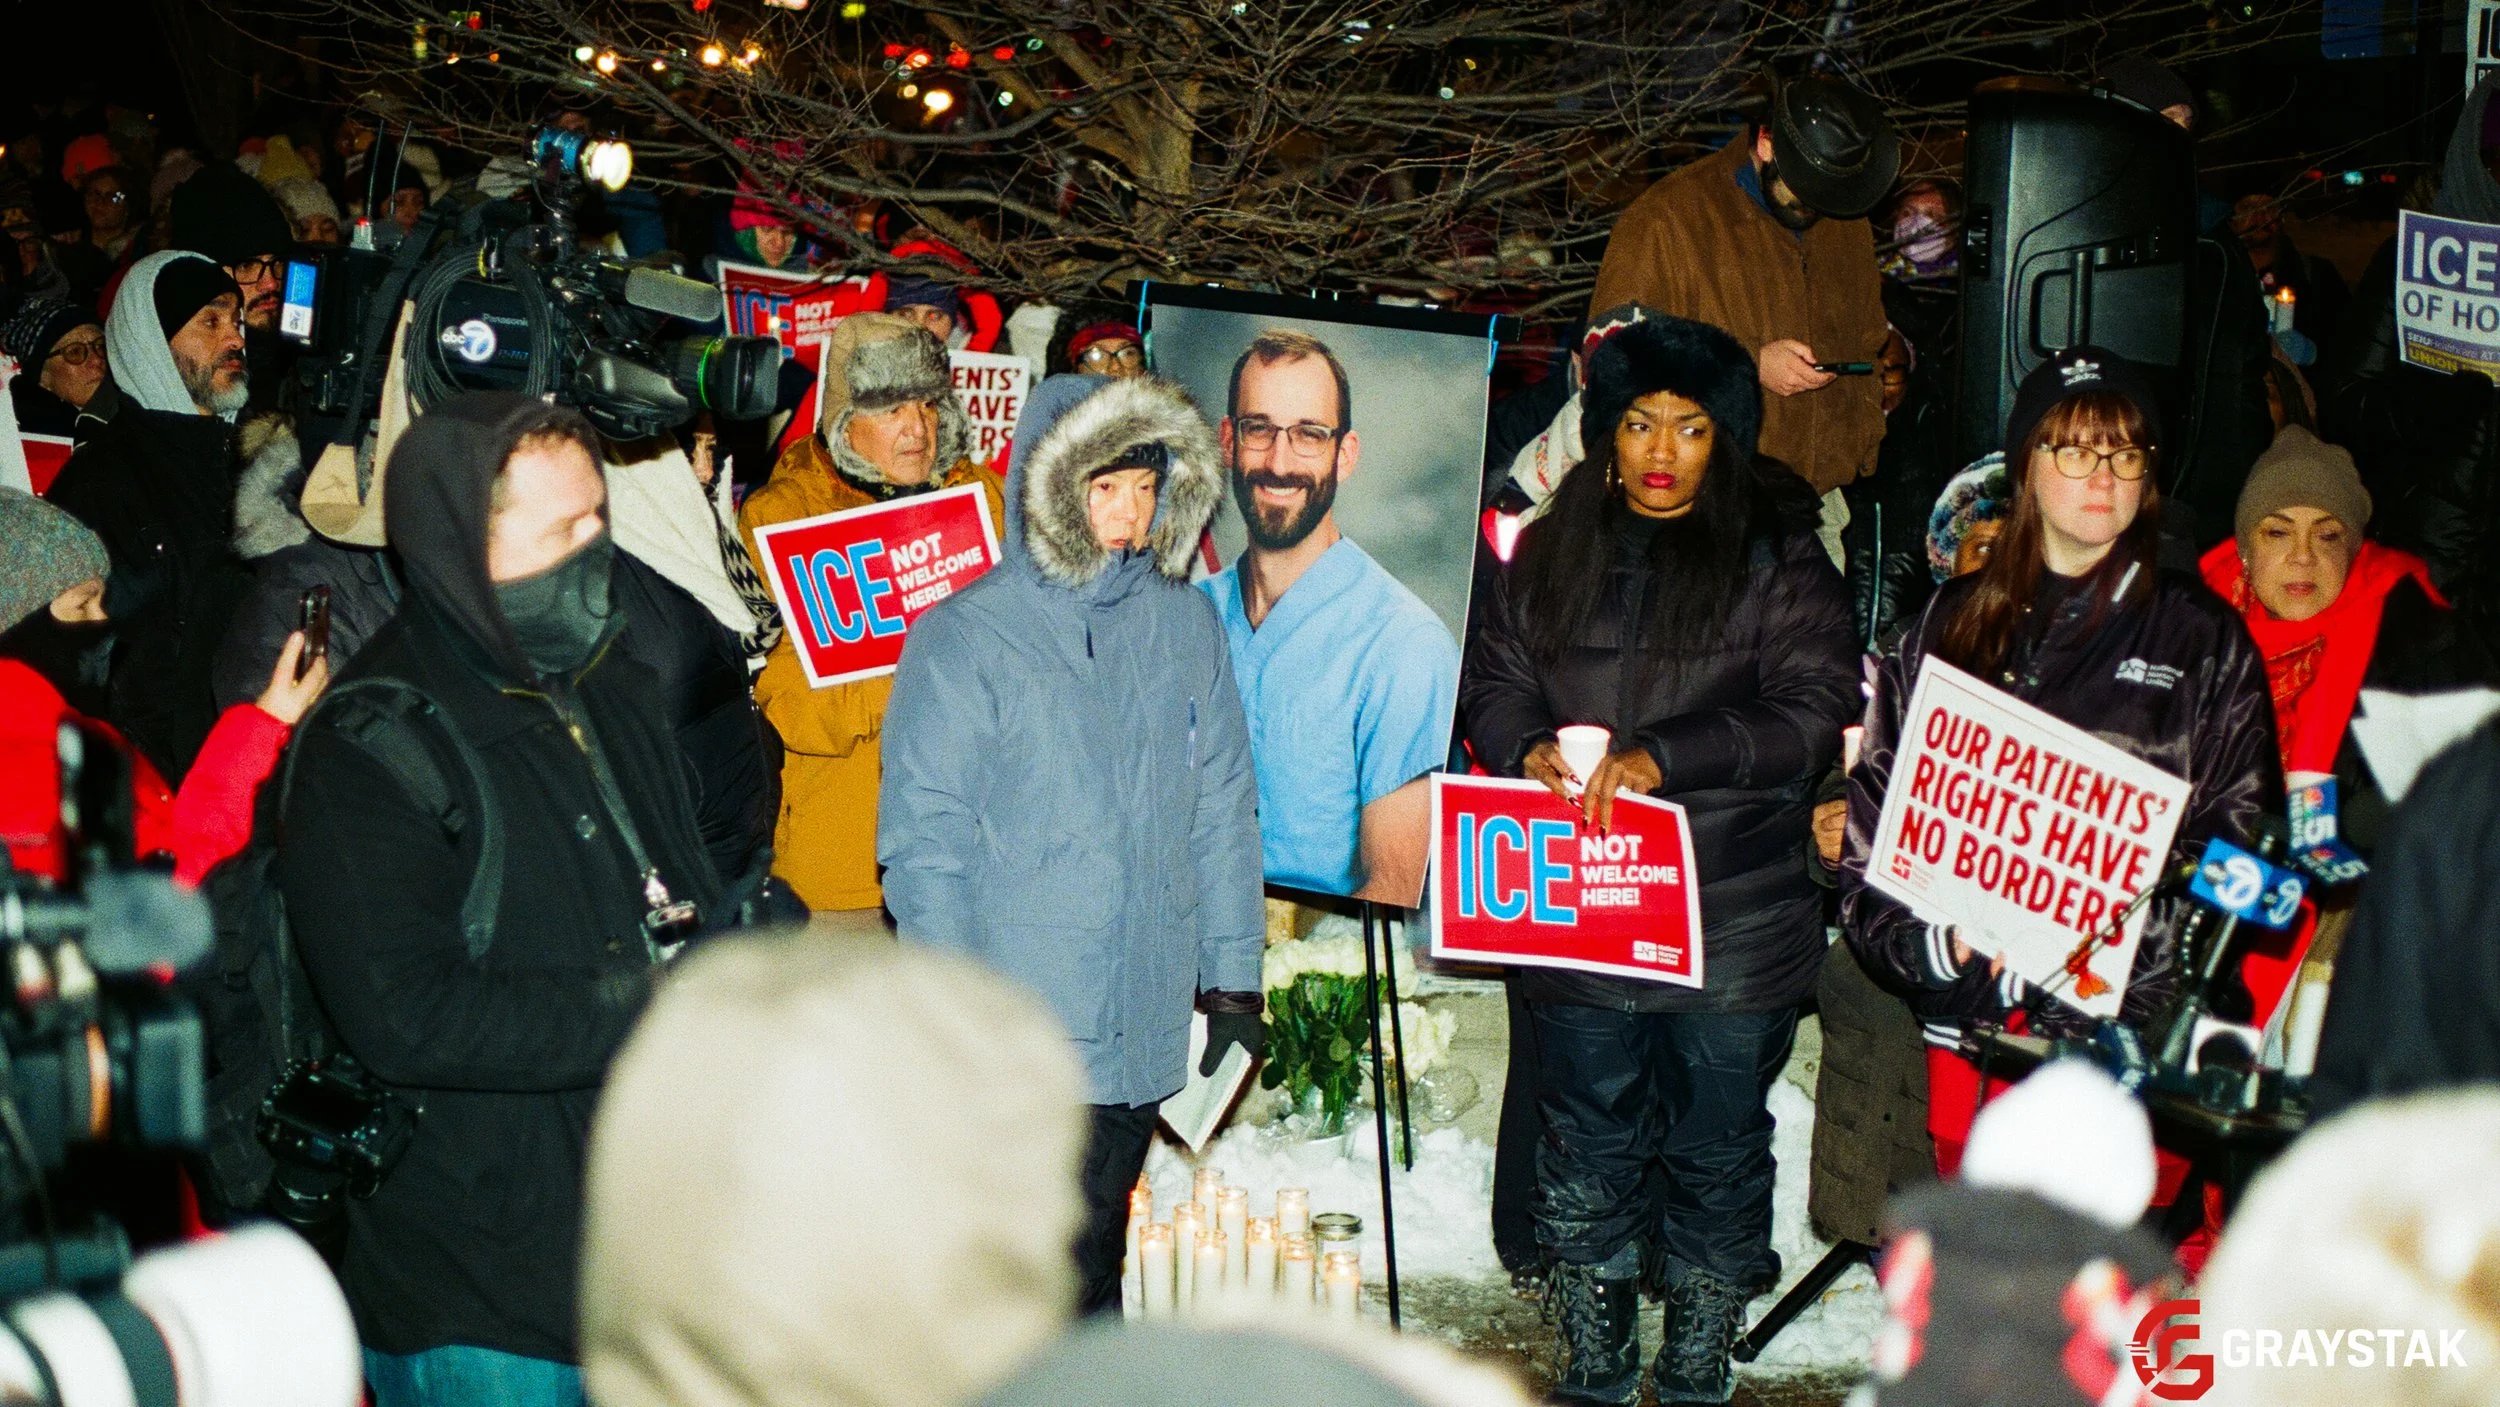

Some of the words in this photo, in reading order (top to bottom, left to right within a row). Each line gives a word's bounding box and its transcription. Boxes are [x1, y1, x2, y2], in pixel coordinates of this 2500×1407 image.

[2412, 231, 2498, 291] ICE
[795, 301, 835, 320] NOT
[2403, 290, 2444, 321] OF
[2453, 300, 2500, 333] HO
[441, 331, 466, 345] abc
[460, 320, 496, 361] 7
[2064, 372, 2102, 386] adidas
[966, 394, 1018, 421] AVE
[889, 531, 942, 573] NOT
[896, 546, 984, 592] WELCOME
[788, 537, 907, 648] ICE
[901, 580, 952, 613] HERE!
[2150, 665, 2184, 678] National
[1925, 706, 1993, 770] OUR
[1992, 735, 2170, 836] PATIENTS'
[1909, 752, 2040, 846] RIGHTS
[2041, 811, 2152, 896] HAVE
[1580, 834, 1643, 863] NOT
[1457, 812, 1577, 927] ICE
[1580, 864, 1680, 885] WELCOME
[1897, 803, 1948, 866] NO
[1953, 831, 2131, 948] BORDERS
[1580, 887, 1641, 907] HERE!
